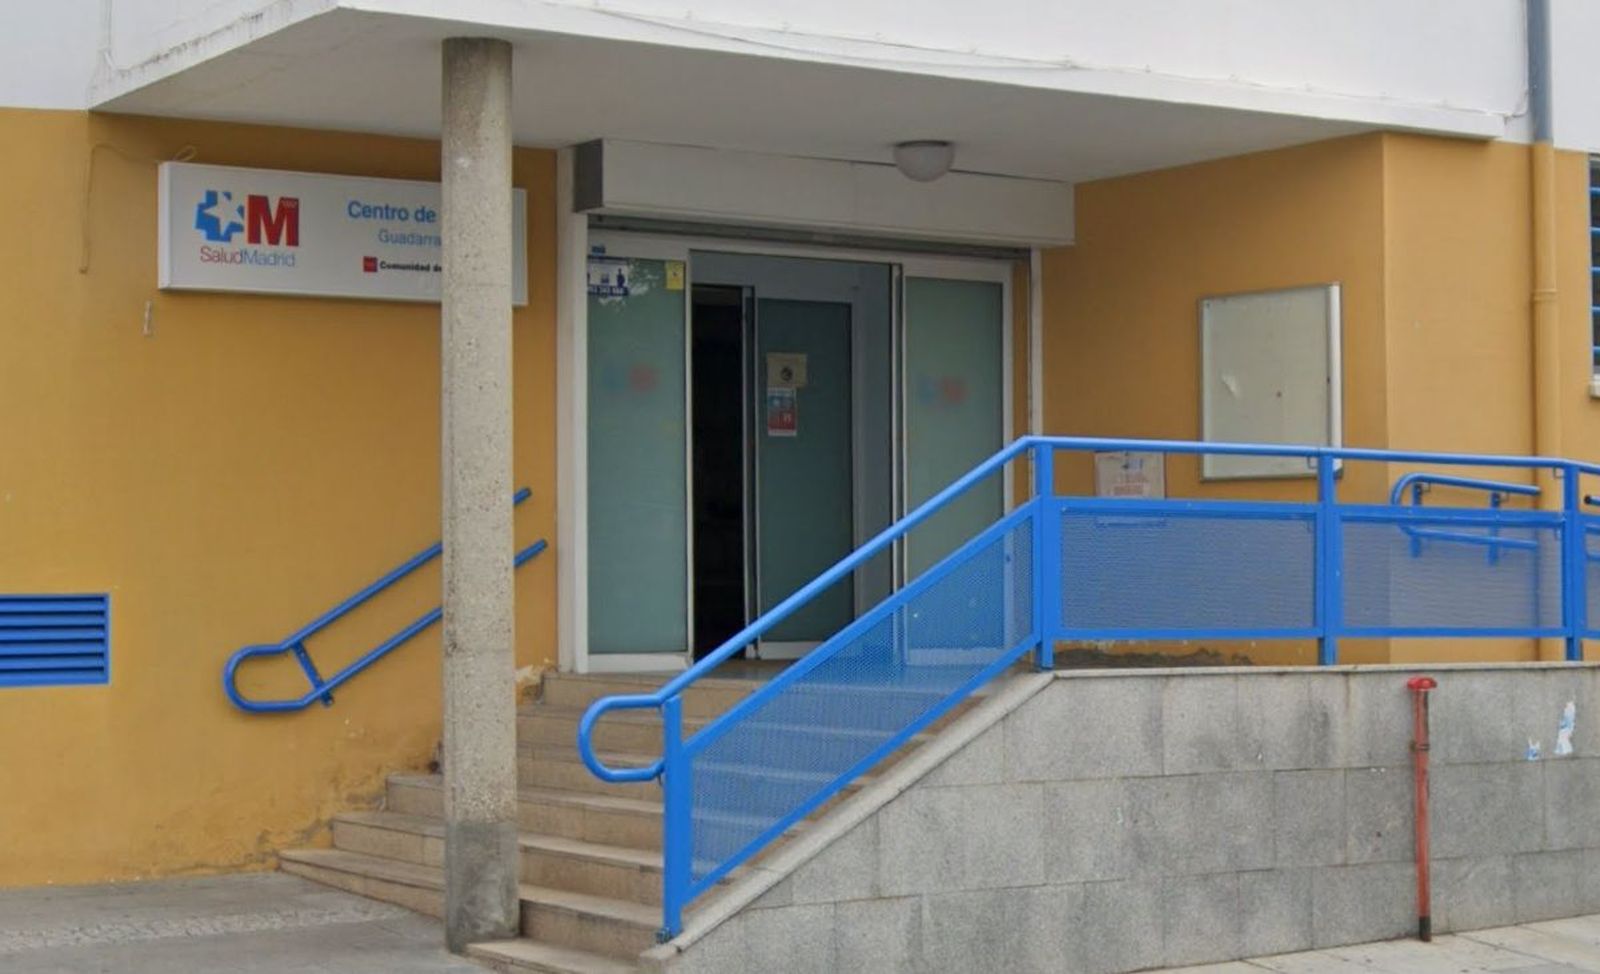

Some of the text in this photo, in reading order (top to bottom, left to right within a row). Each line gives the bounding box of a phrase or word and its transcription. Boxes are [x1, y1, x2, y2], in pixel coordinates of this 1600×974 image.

[347, 201, 437, 223] Centro de
[378, 228, 442, 247] Guadarra
[200, 246, 296, 267] SaludMadrid
[380, 261, 431, 272] Comunidad
